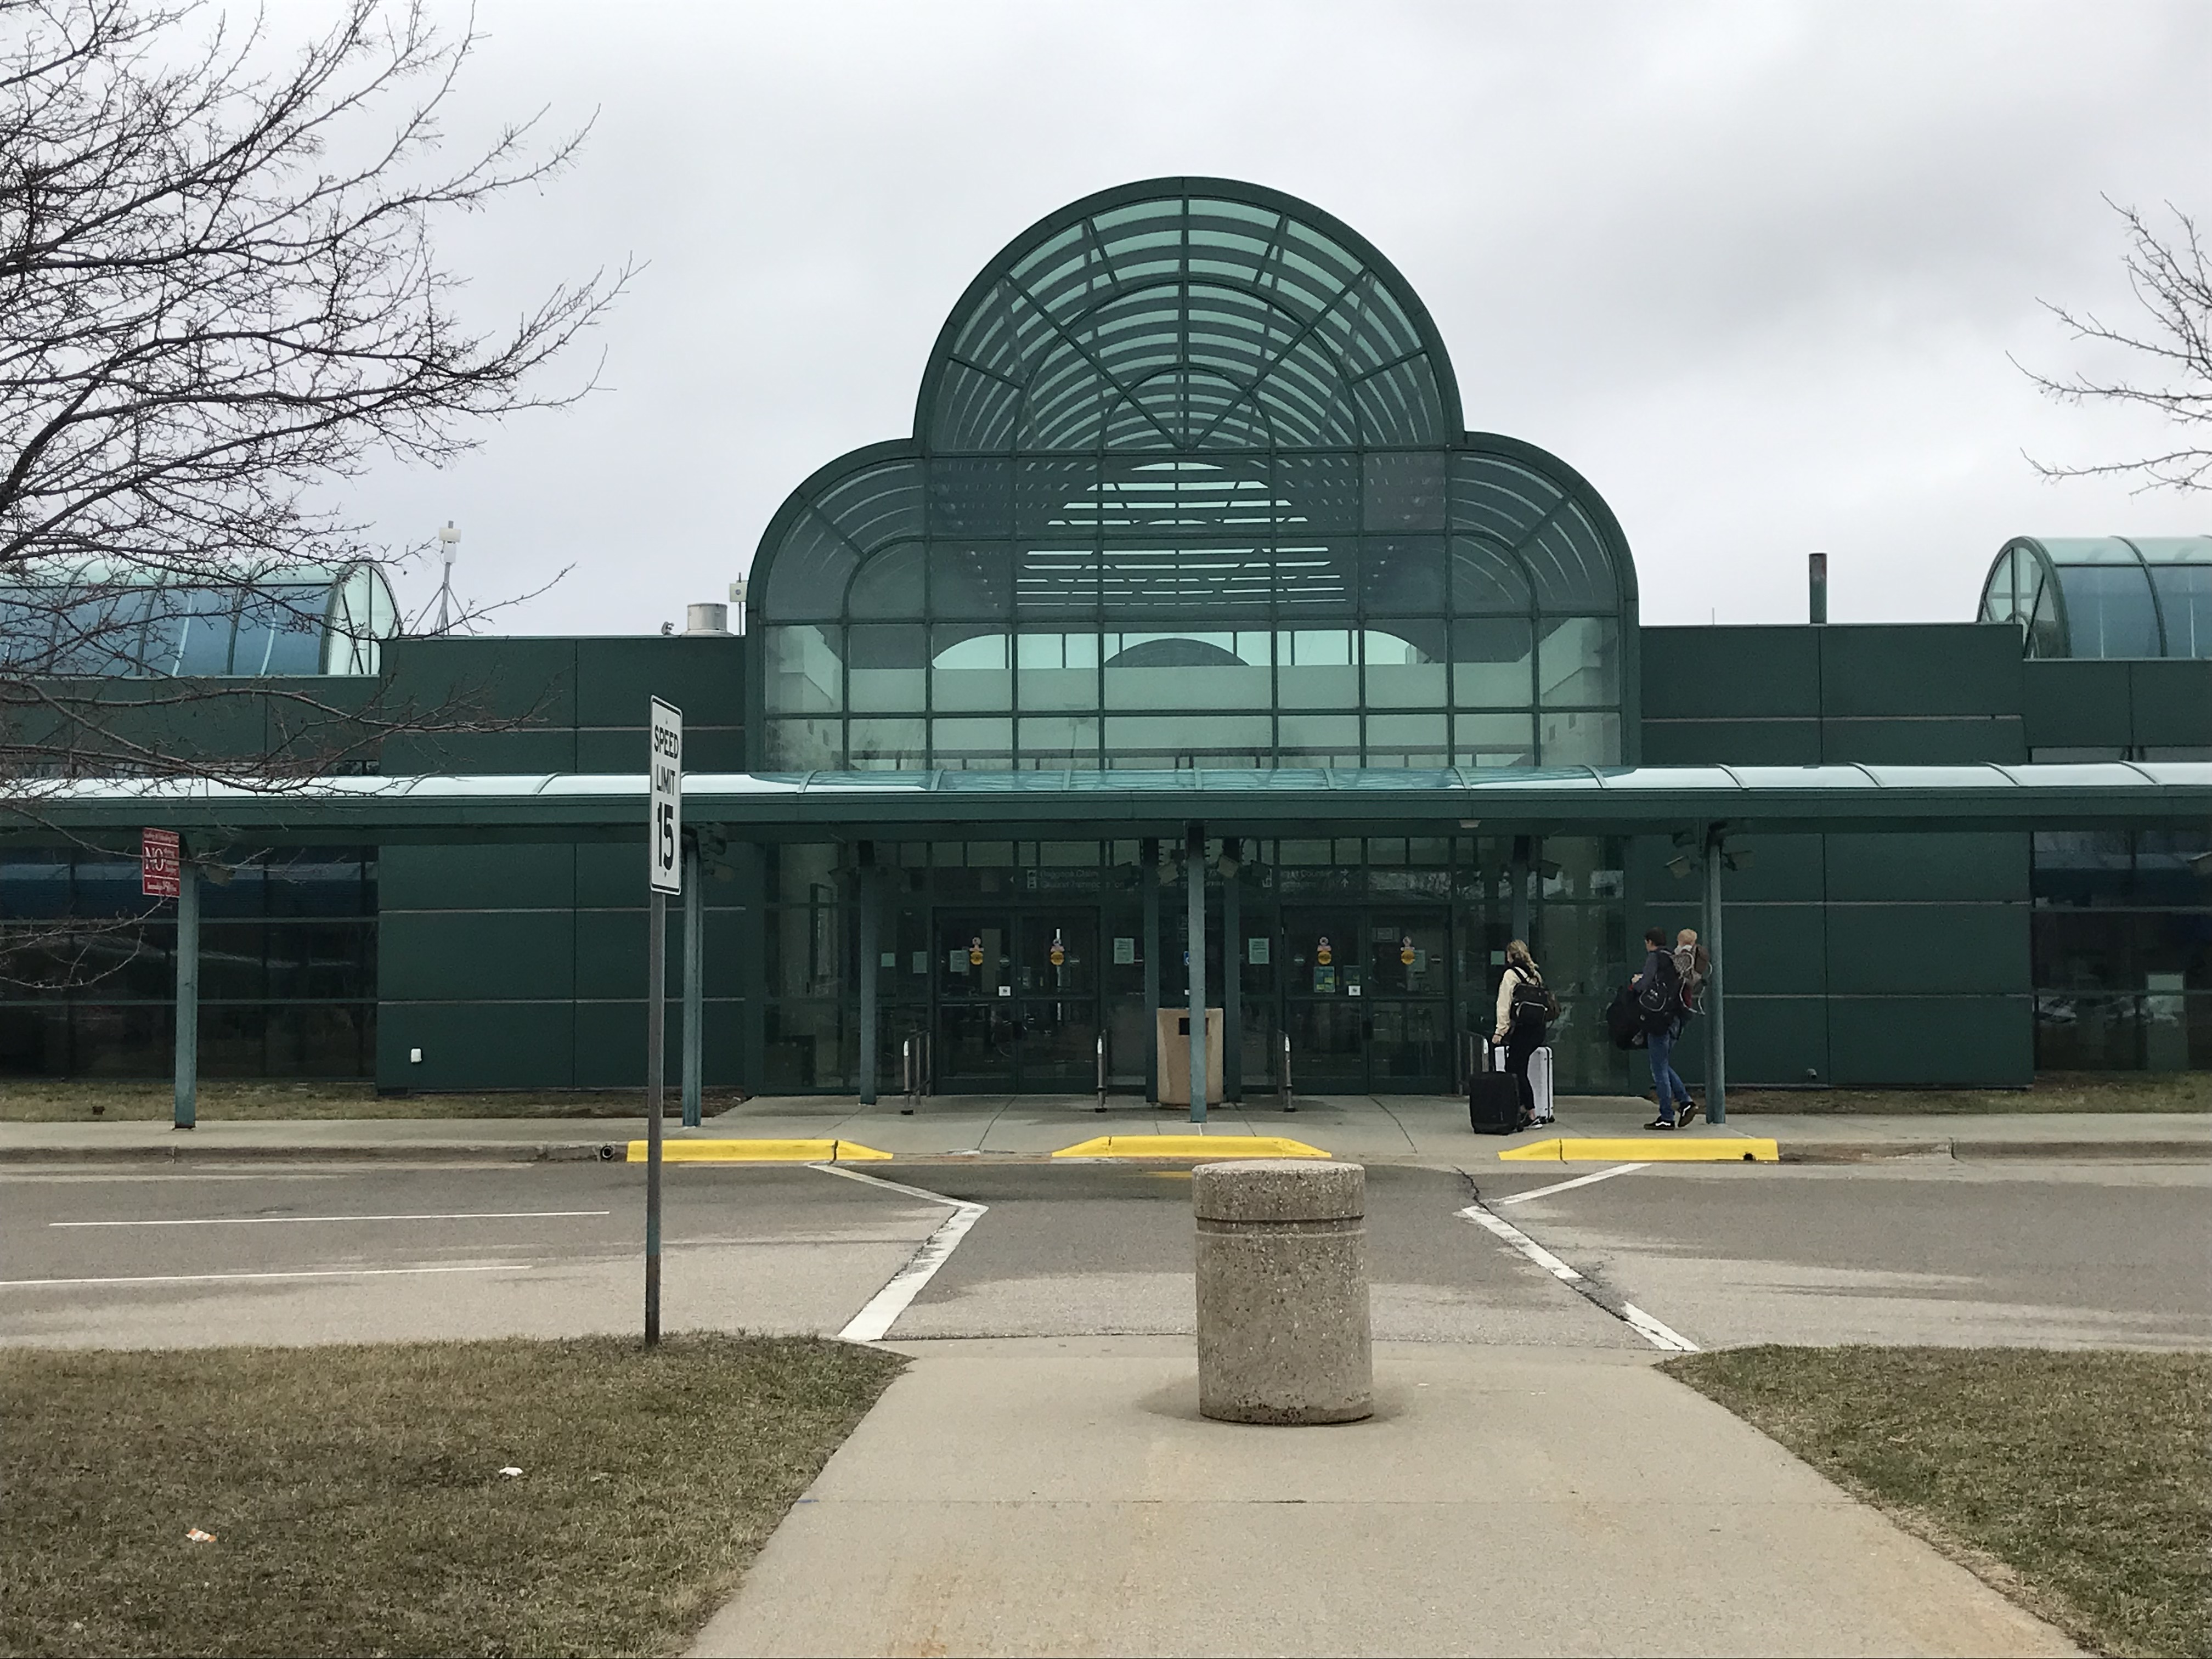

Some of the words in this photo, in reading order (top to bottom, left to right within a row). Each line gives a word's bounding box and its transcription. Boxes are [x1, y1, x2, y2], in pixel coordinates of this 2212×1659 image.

[654, 724, 679, 759] SPEED
[656, 763, 675, 796] LIMIT
[657, 801, 674, 871] 15
[145, 847, 163, 871] NO
